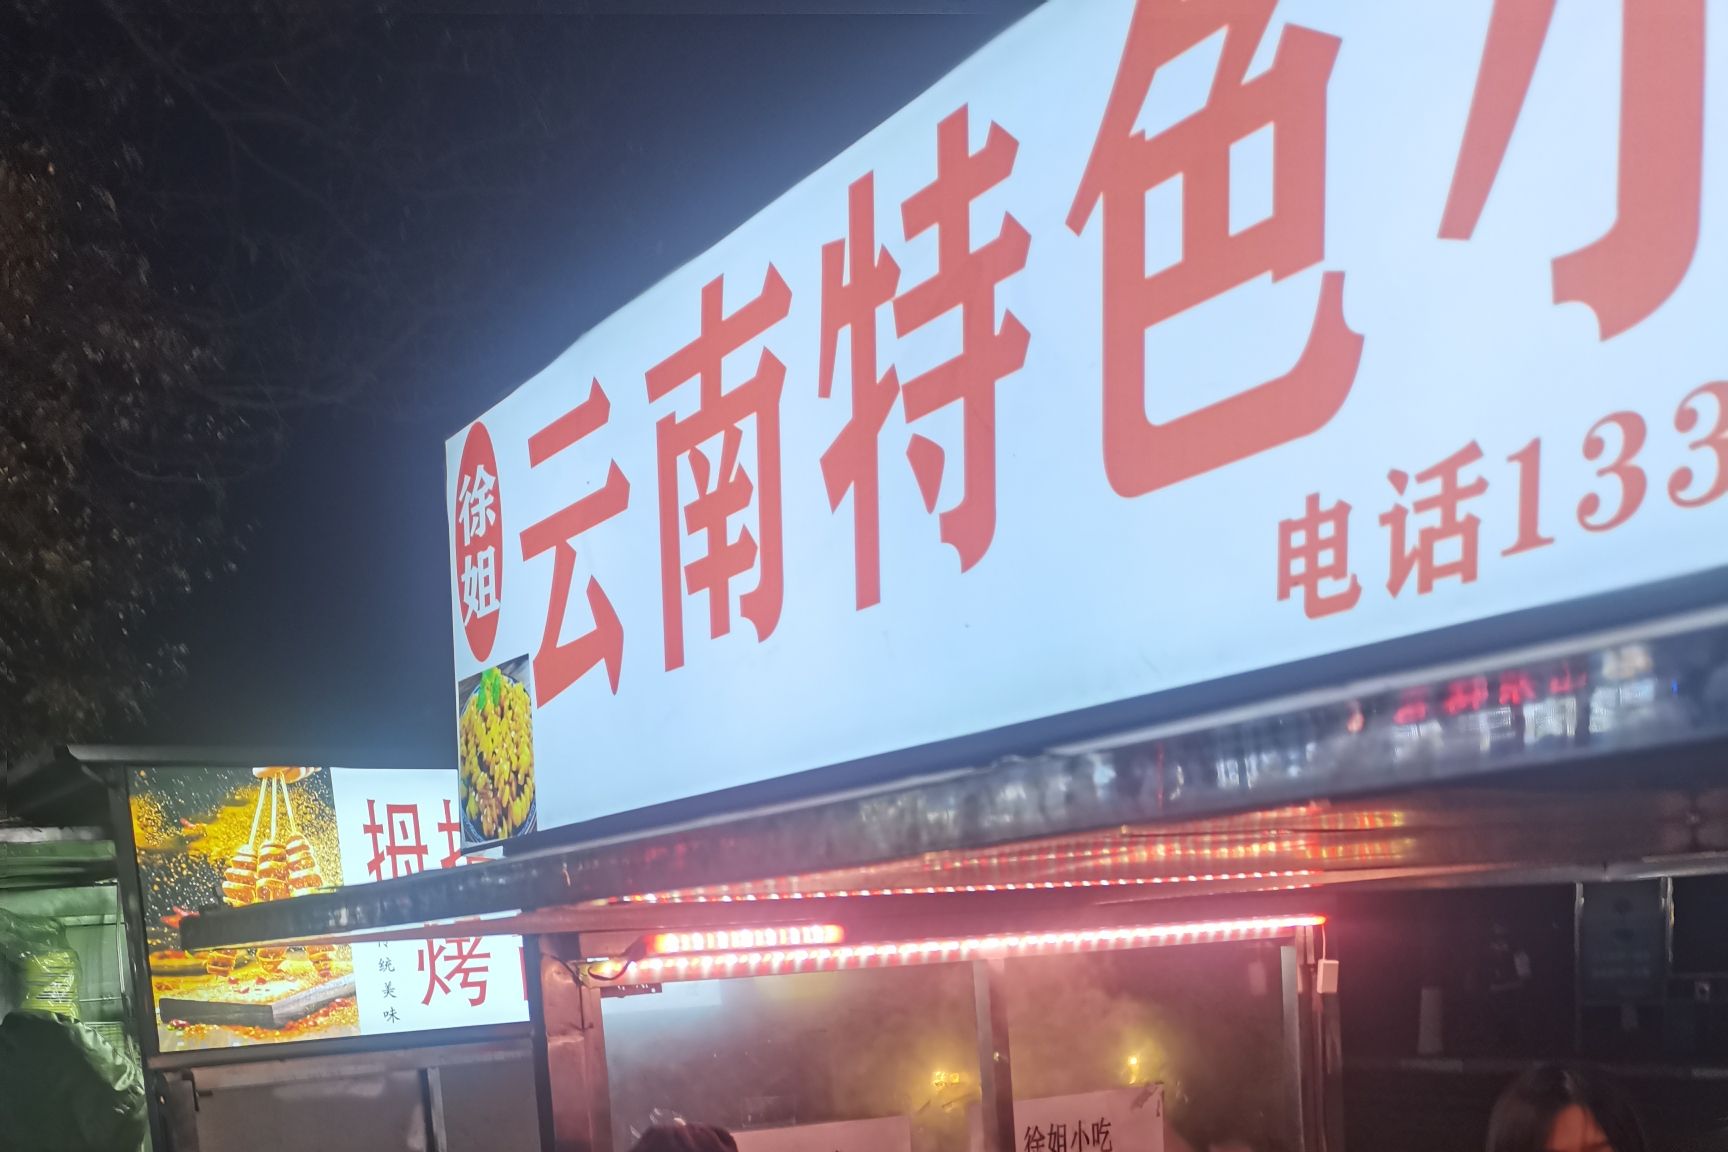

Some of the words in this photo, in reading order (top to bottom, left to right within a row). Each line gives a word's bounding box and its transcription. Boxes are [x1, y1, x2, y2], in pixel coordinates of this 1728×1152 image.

[458, 464, 501, 627] 徐姐
[362, 799, 497, 881] 拇
[377, 940, 400, 1024] 统美味
